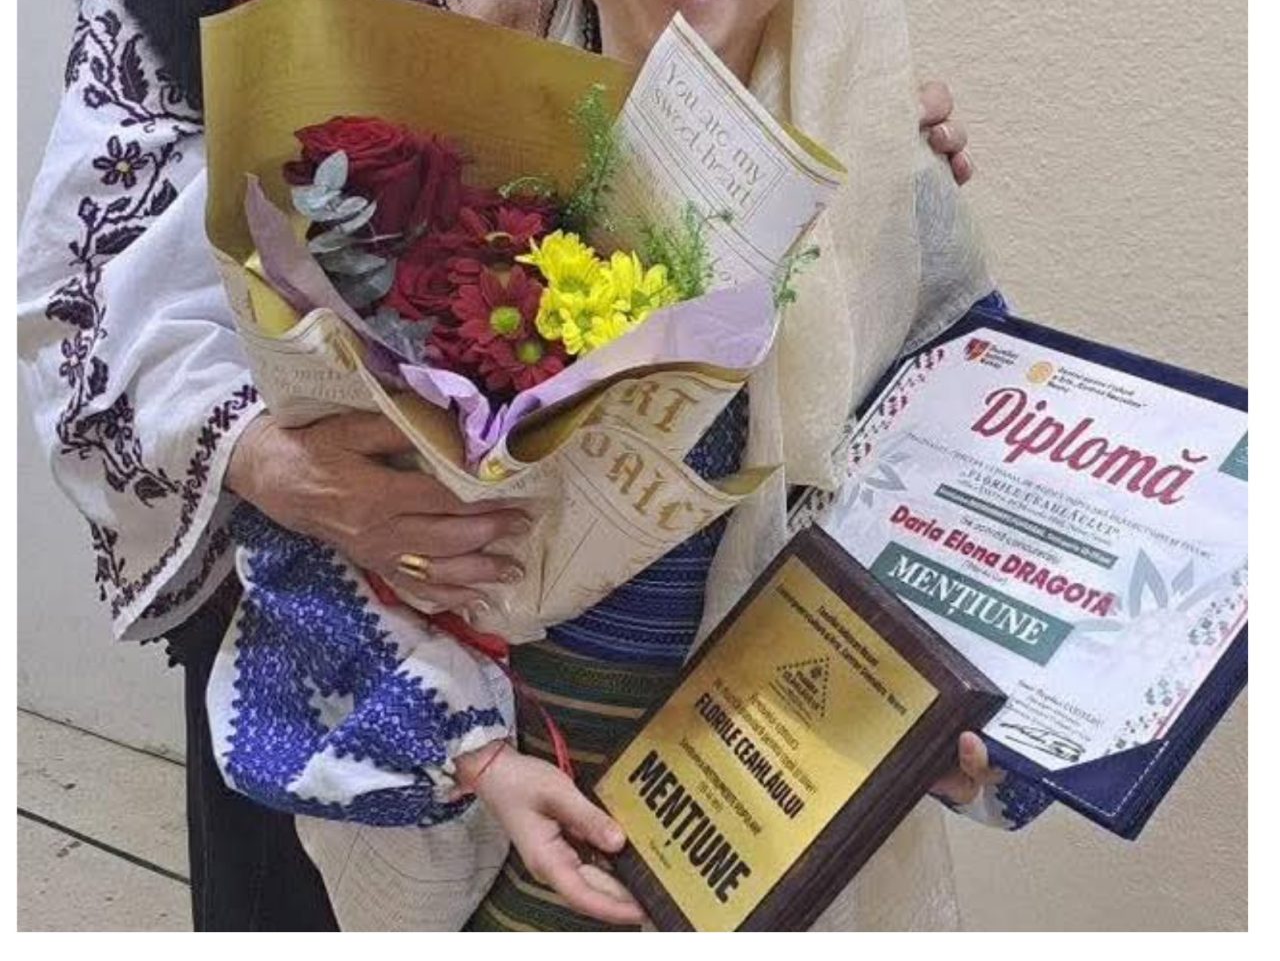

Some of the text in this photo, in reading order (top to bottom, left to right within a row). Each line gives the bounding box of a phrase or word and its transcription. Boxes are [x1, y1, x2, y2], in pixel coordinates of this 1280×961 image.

[666, 63, 699, 110] You
[732, 148, 767, 185] my
[970, 387, 1208, 505] Diplomă
[889, 502, 946, 543] Daria
[942, 525, 1004, 569] Elena
[886, 552, 1048, 646] MENȚIUNE
[691, 692, 743, 747] FLORILE
[628, 749, 751, 904] MENȚIUNE
